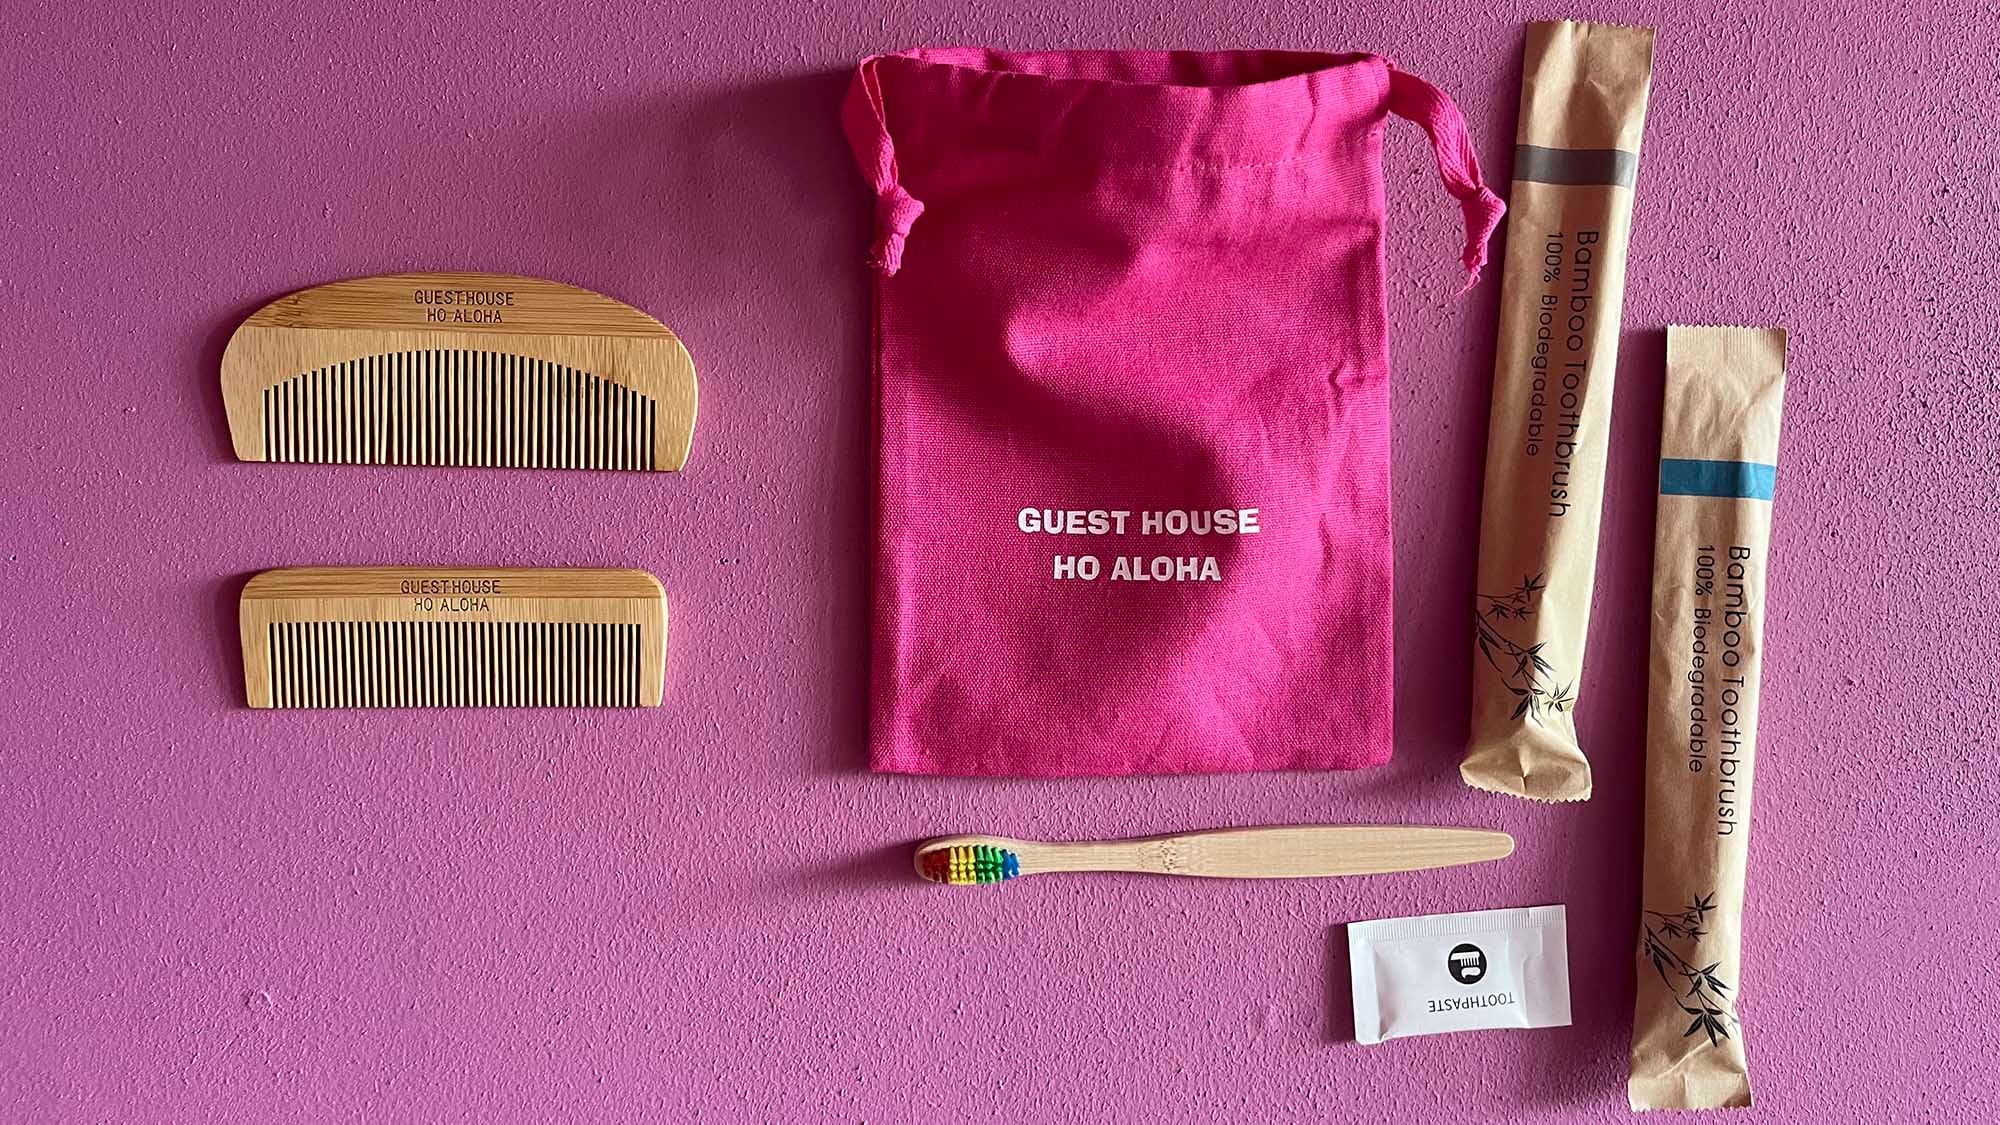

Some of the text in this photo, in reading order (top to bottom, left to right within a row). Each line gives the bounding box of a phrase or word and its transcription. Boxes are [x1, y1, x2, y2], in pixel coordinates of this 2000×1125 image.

[427, 308, 502, 323] HO ALOHA
[1526, 231, 1564, 457] 100% Biodegradable
[1548, 231, 1599, 517] Bamboo Toothbrush
[1017, 507, 1260, 535] GUEST HOUSE
[1053, 554, 1222, 582] HO ALOHA
[414, 597, 489, 612] HO ALOHA
[1687, 545, 1715, 773] 100% Biodegradable
[1717, 546, 1750, 836] Bamboo Toothbrush
[1427, 992, 1515, 1013] TOOTHPASTE
